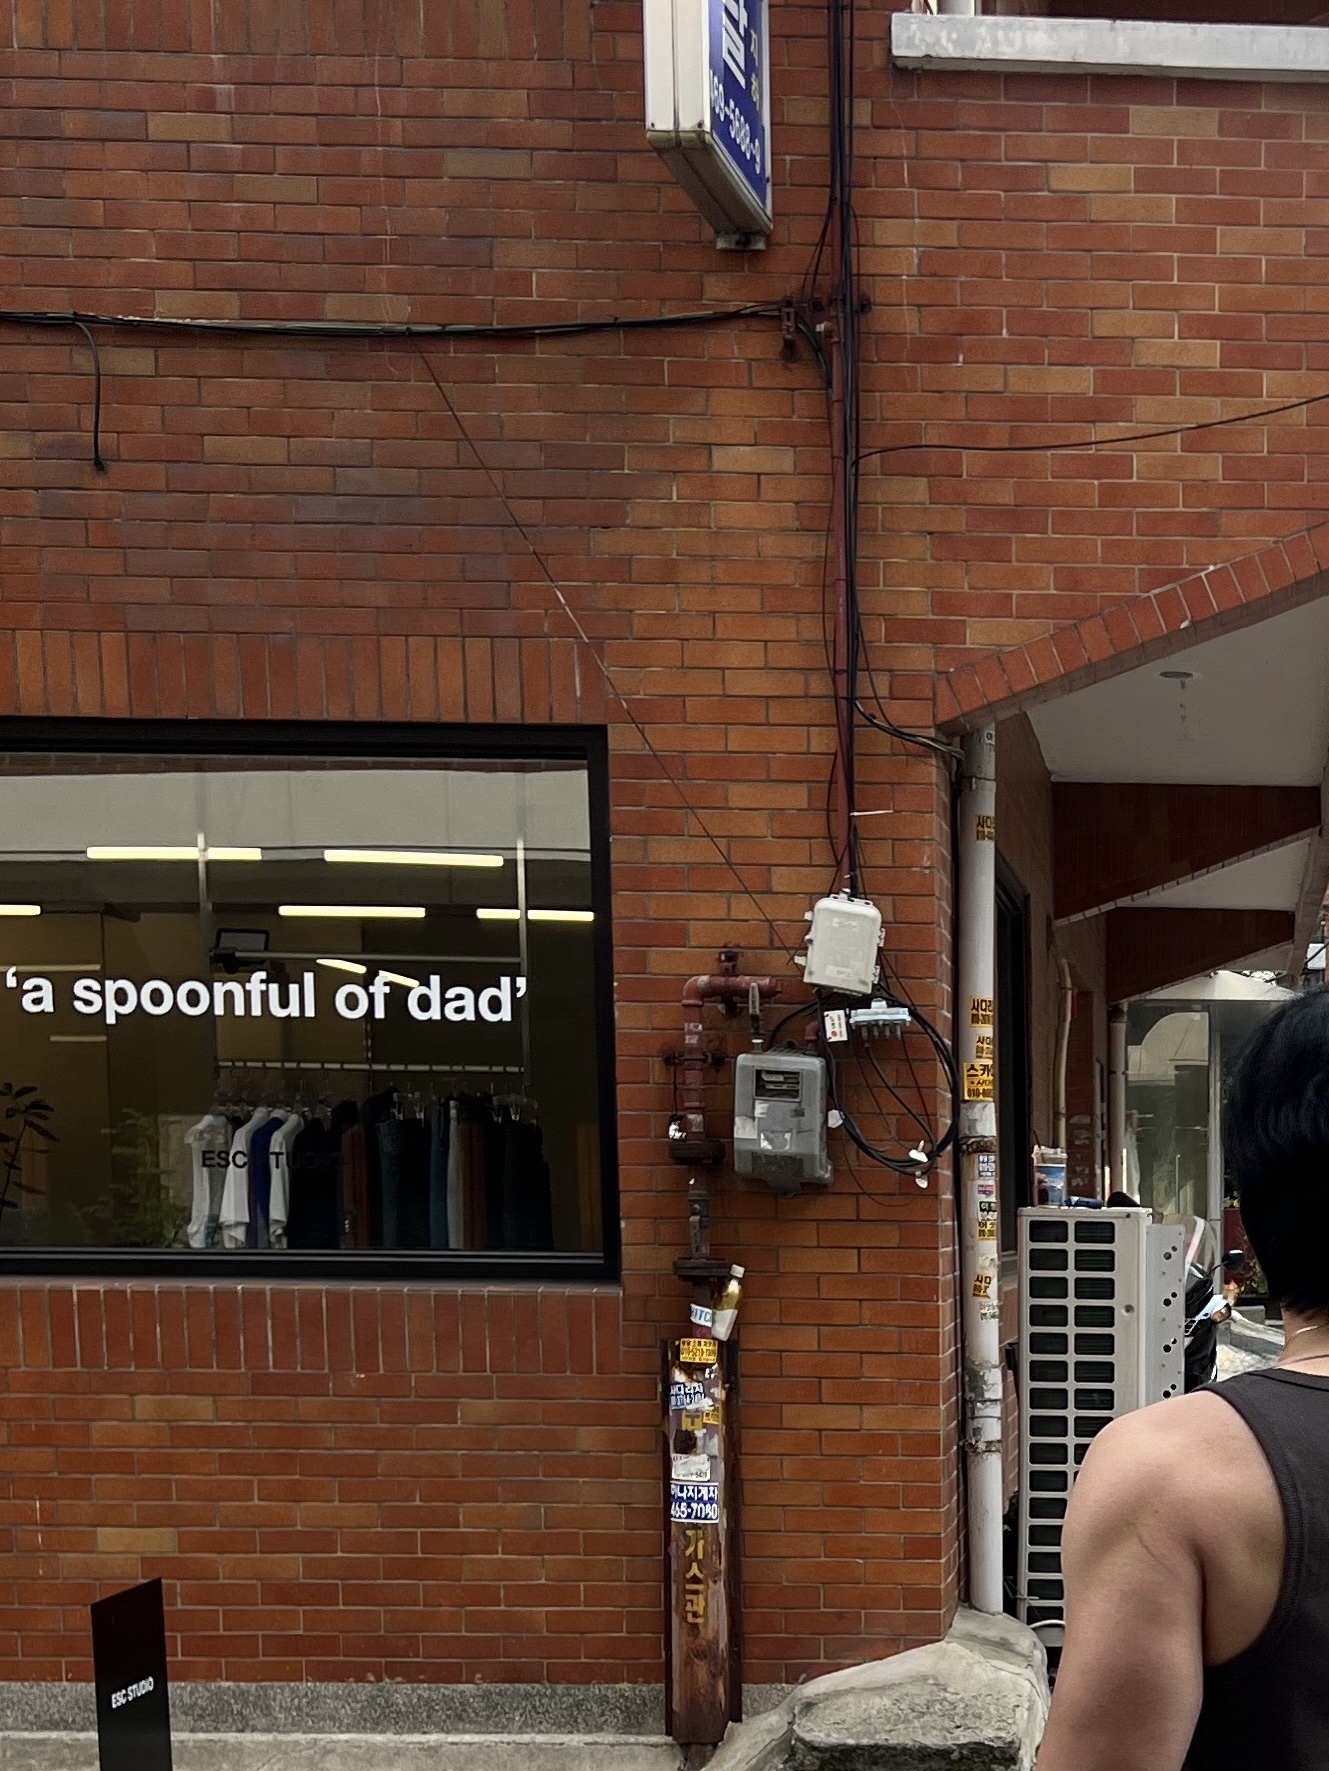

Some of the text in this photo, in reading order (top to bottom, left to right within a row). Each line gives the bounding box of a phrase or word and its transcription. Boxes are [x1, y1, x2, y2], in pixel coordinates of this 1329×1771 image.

[72, 972, 316, 1025] spoonful
[335, 977, 389, 1020] of
[407, 976, 527, 1022] dad’
[201, 1150, 248, 1169] ESC
[111, 1676, 154, 1709] ESC STUDIO
